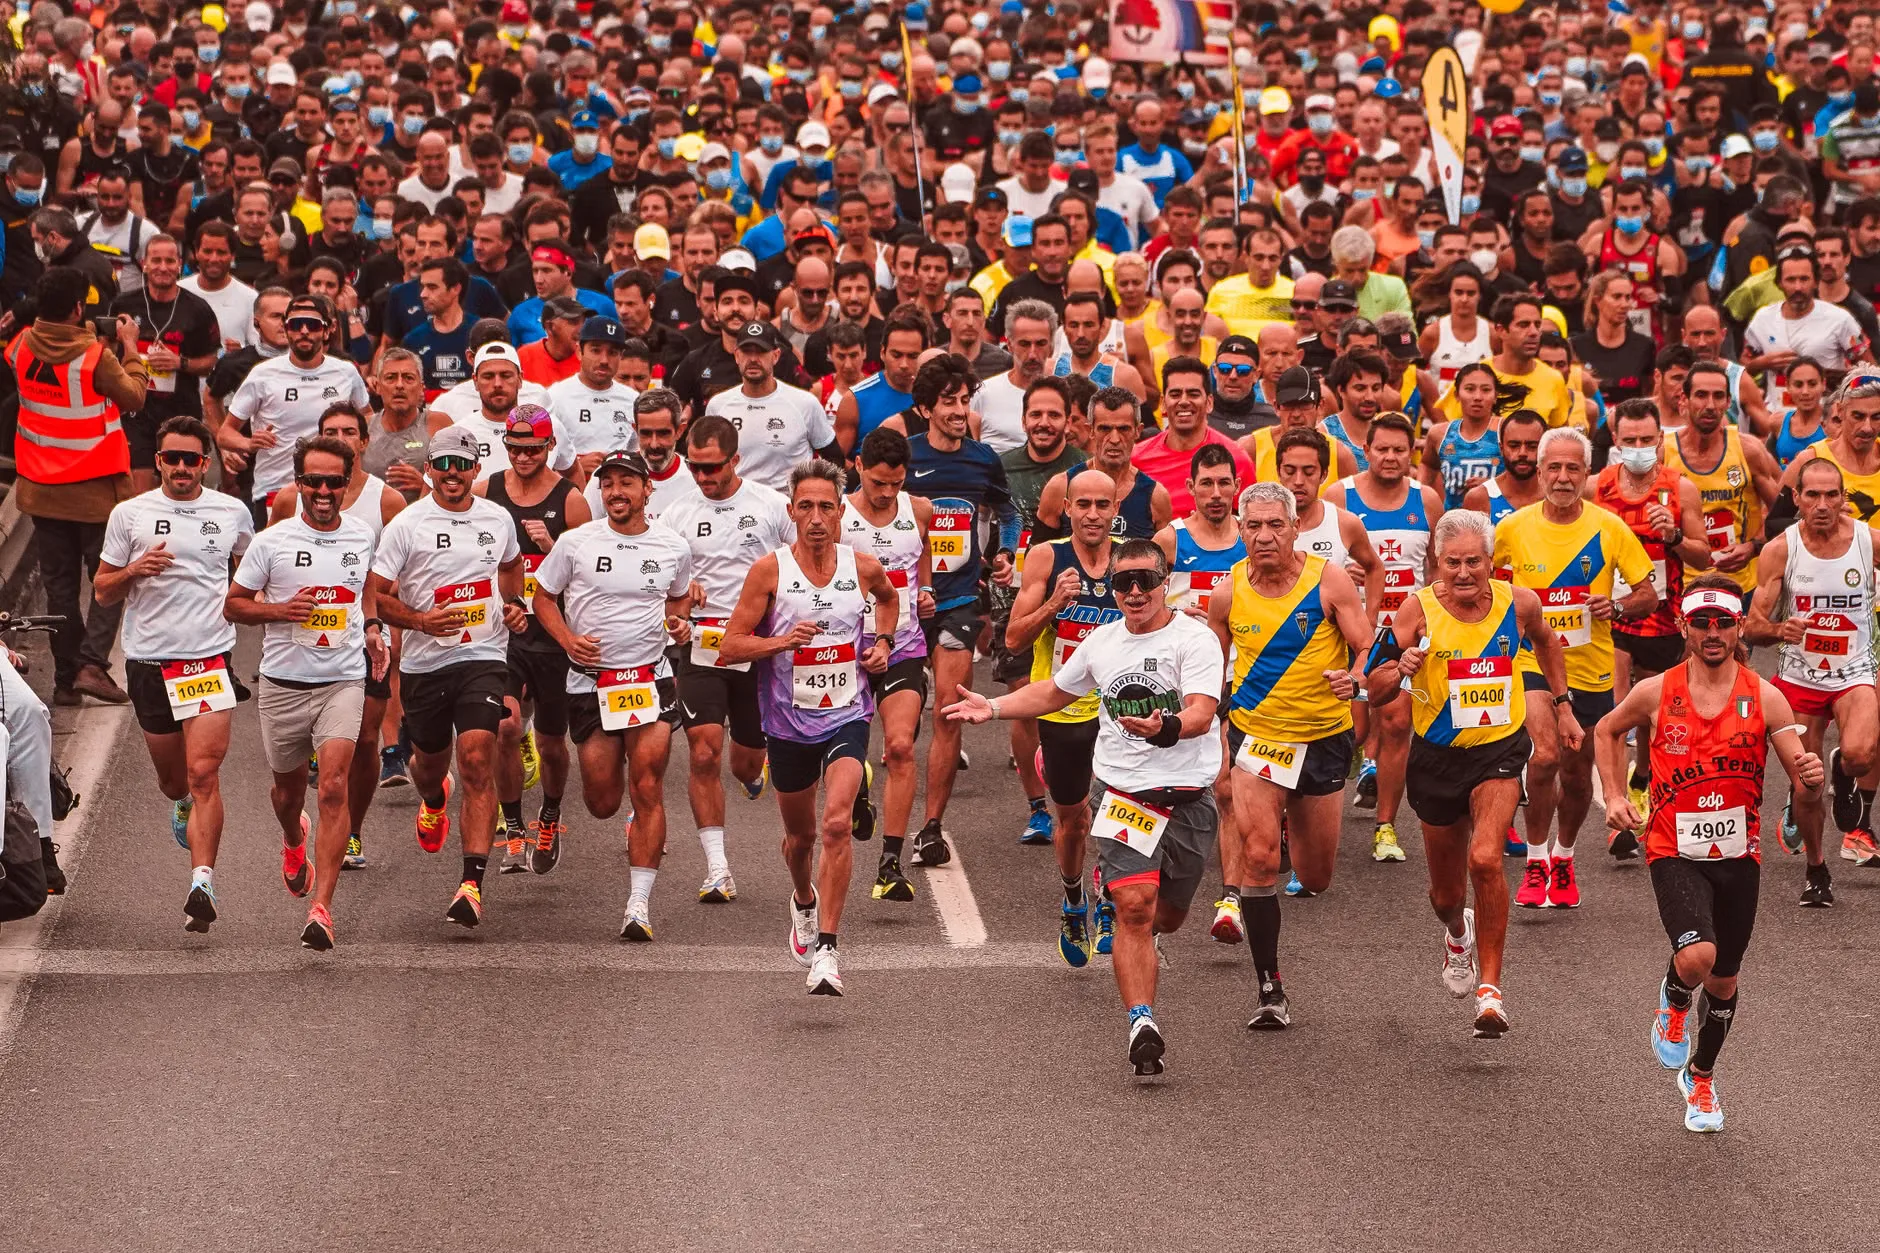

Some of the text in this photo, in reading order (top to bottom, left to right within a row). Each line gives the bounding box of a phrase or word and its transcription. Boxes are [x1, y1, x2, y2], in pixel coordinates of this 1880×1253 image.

[155, 520, 171, 535] B
[697, 521, 712, 537] B
[935, 514, 955, 531] edp
[436, 533, 451, 549] B
[932, 540, 955, 553] 156
[295, 551, 312, 568] B
[595, 556, 612, 573] B
[1385, 571, 1400, 587] dp
[316, 587, 337, 604] edp
[454, 584, 477, 600] edp
[1549, 589, 1572, 606] edp
[311, 613, 338, 627] 209
[1545, 615, 1583, 632] 0411
[1817, 614, 1841, 631] edp
[1814, 638, 1840, 653] 288
[815, 647, 839, 664] edp
[616, 668, 639, 684] edp
[1469, 660, 1495, 678] edp
[178, 679, 222, 699] 10421
[805, 672, 847, 689] 4318
[1110, 676, 1158, 695] DIRECTIVO
[618, 694, 644, 710] 210
[1461, 687, 1504, 705] 10400
[1251, 743, 1294, 765] 10410
[1671, 760, 1706, 785] dei
[1697, 791, 1725, 810] edp
[1109, 804, 1154, 832] 10416
[1691, 819, 1737, 841] 4902
